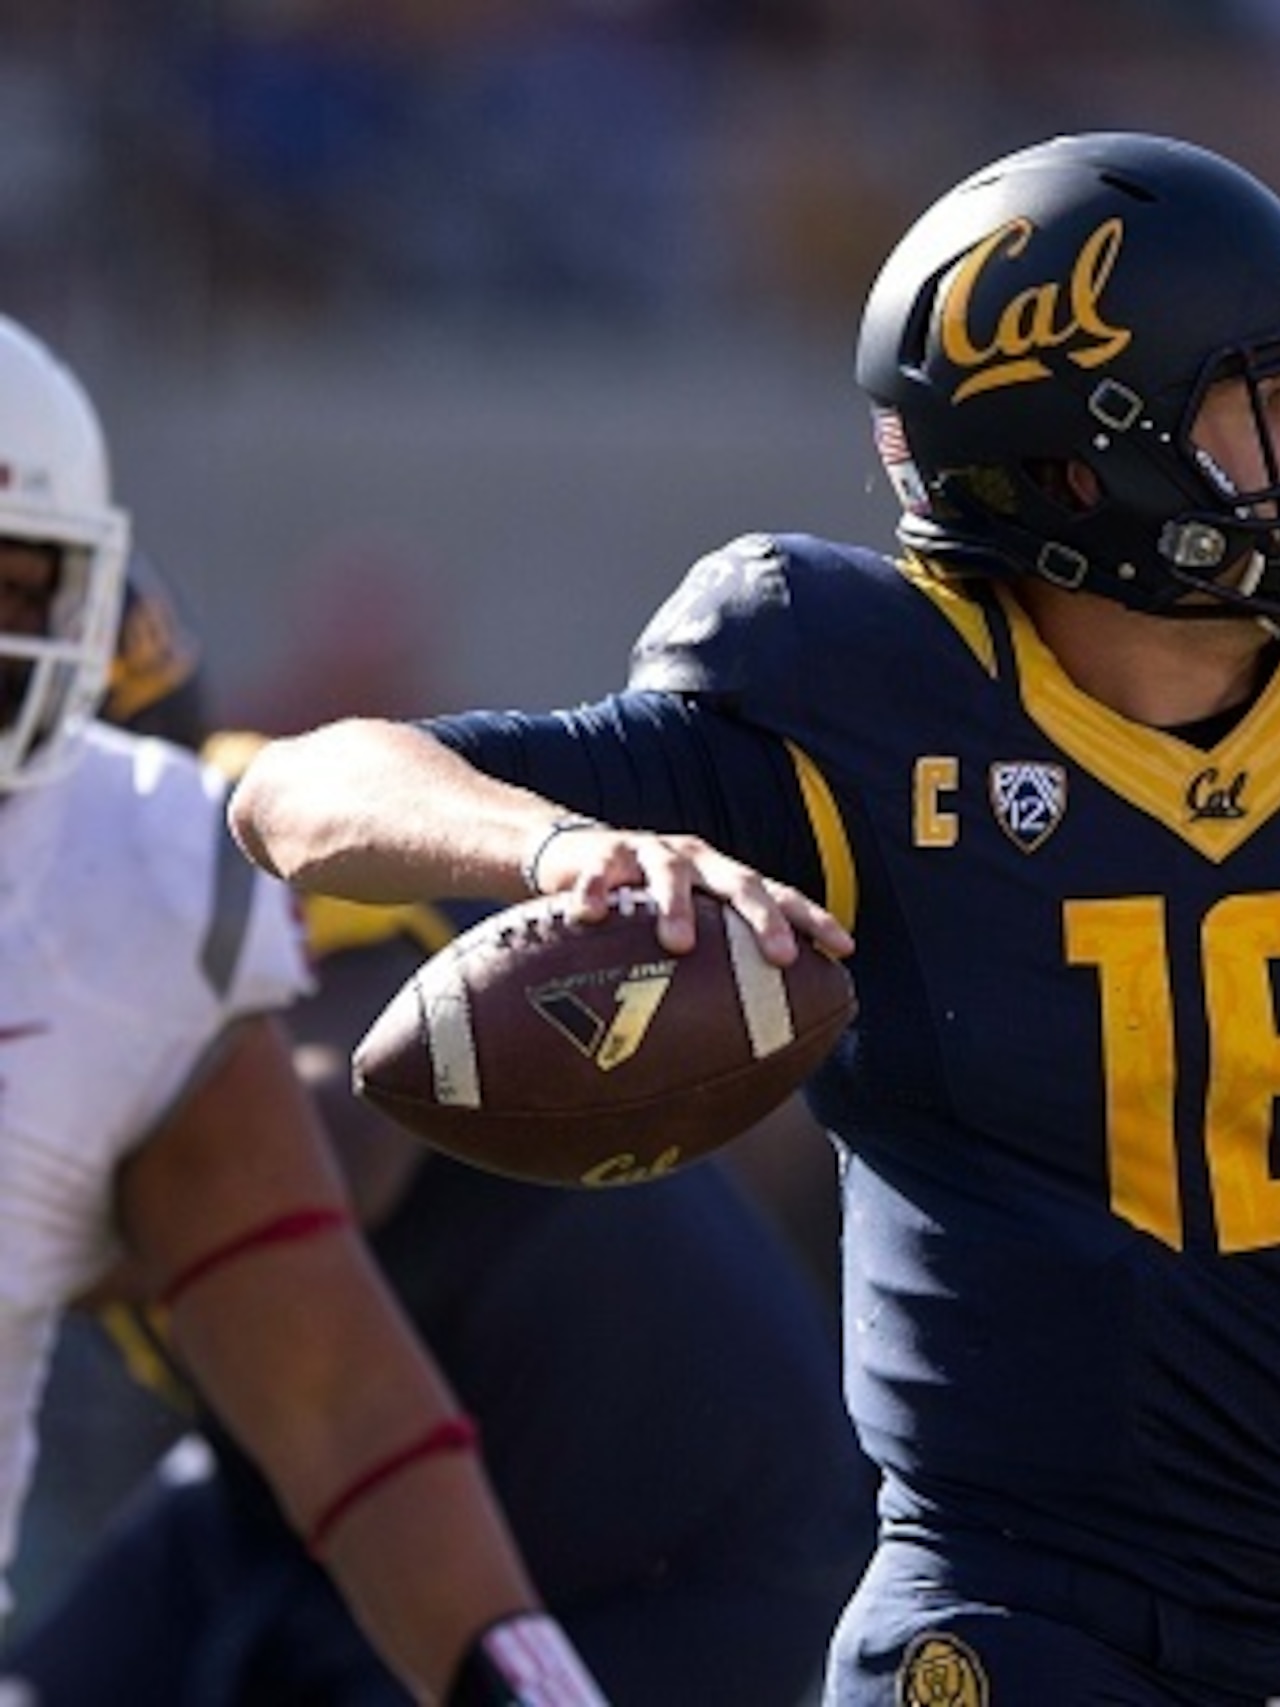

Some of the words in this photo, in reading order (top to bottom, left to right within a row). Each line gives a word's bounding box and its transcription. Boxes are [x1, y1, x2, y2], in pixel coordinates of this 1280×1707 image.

[942, 217, 1132, 405] Cal
[913, 756, 960, 847] C
[1009, 797, 1047, 830] 12
[1186, 767, 1248, 821] Cal
